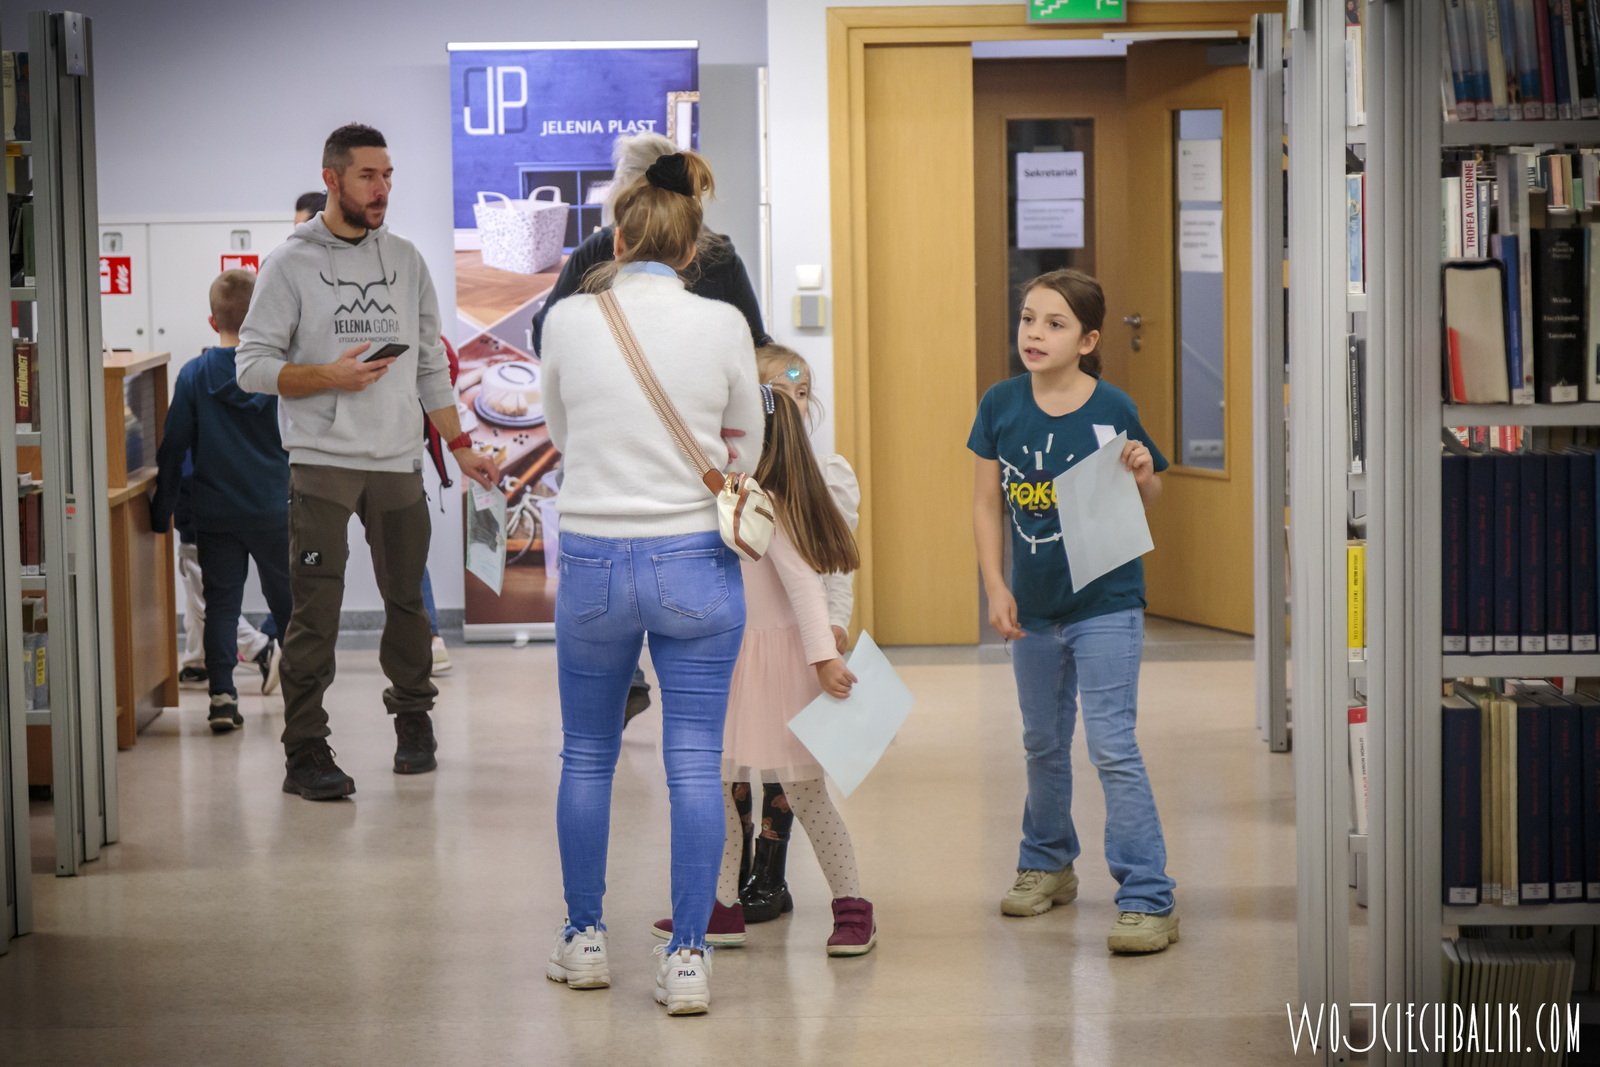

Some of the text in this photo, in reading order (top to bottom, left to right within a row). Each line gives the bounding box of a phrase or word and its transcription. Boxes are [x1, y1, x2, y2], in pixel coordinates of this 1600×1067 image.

[540, 119, 657, 137] JELENIA PLAST
[1024, 168, 1078, 178] Sekretariat
[1464, 162, 1476, 249] TROFEA WOJENNE
[334, 318, 400, 335] JELENIA GÓRA
